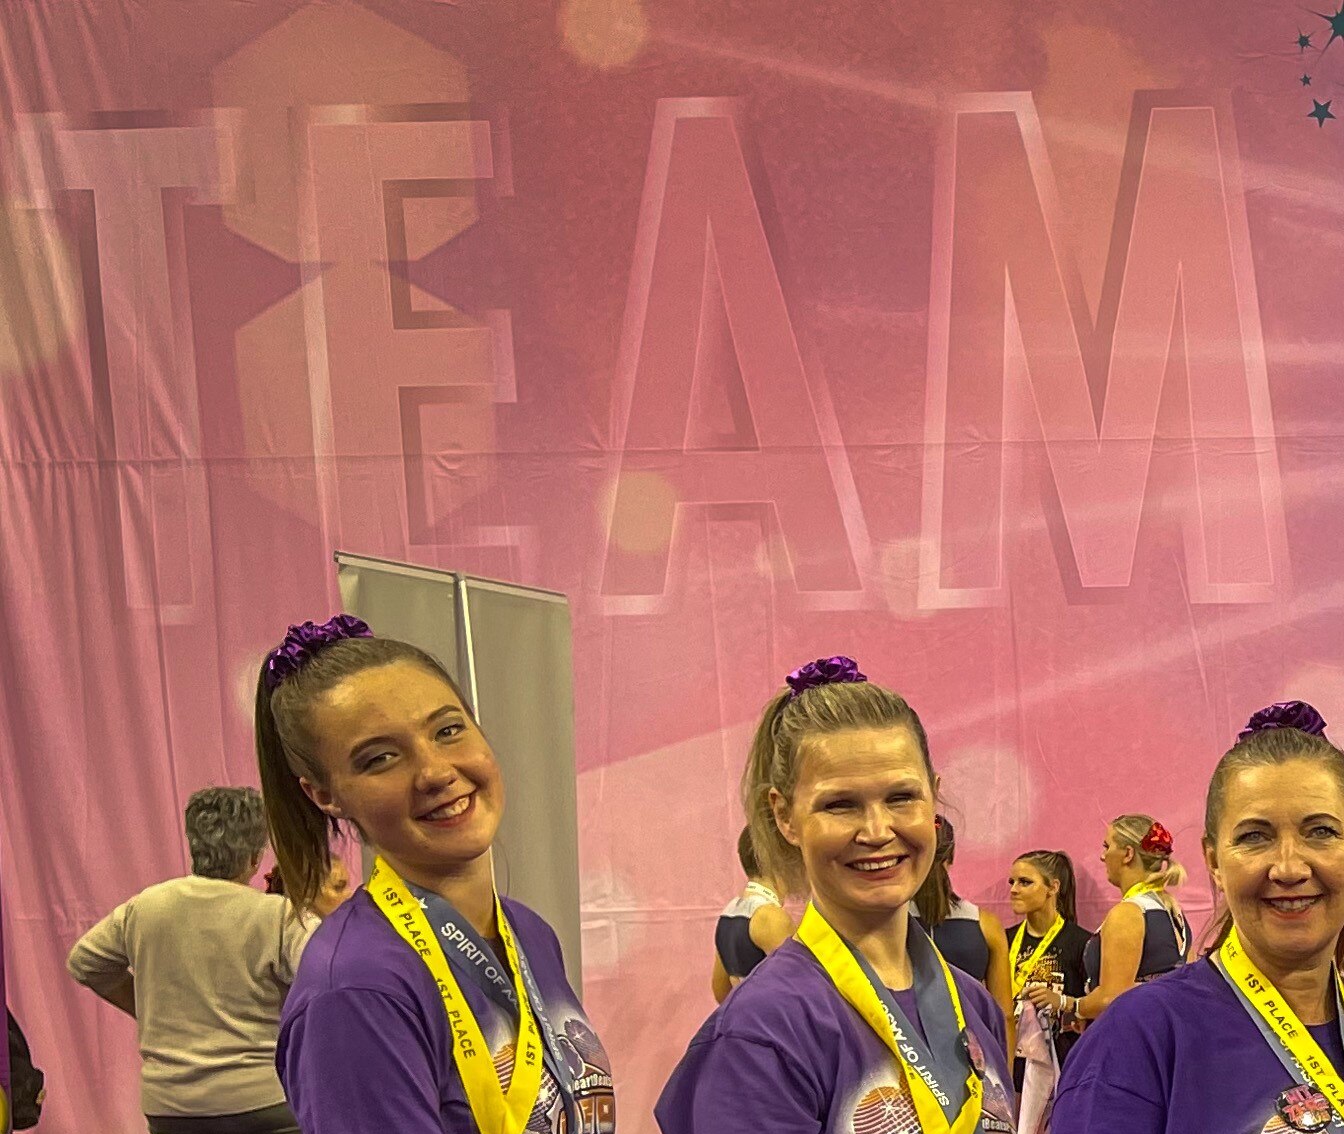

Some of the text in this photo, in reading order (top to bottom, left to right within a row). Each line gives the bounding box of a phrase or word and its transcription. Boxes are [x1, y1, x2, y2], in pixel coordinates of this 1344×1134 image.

[20, 90, 1298, 622] TEAM
[382, 887, 403, 908] 1ST
[399, 912, 432, 957] PLACE
[449, 1010, 477, 1059] PLACE
[441, 922, 506, 986] SPIRIT OF
[525, 1041, 537, 1067] 1ST
[881, 1000, 949, 1106] SPIRIT OF AASC
[1244, 973, 1265, 995] 1ST
[1264, 1001, 1299, 1040] PLACE
[1306, 1055, 1325, 1077] 1ST
